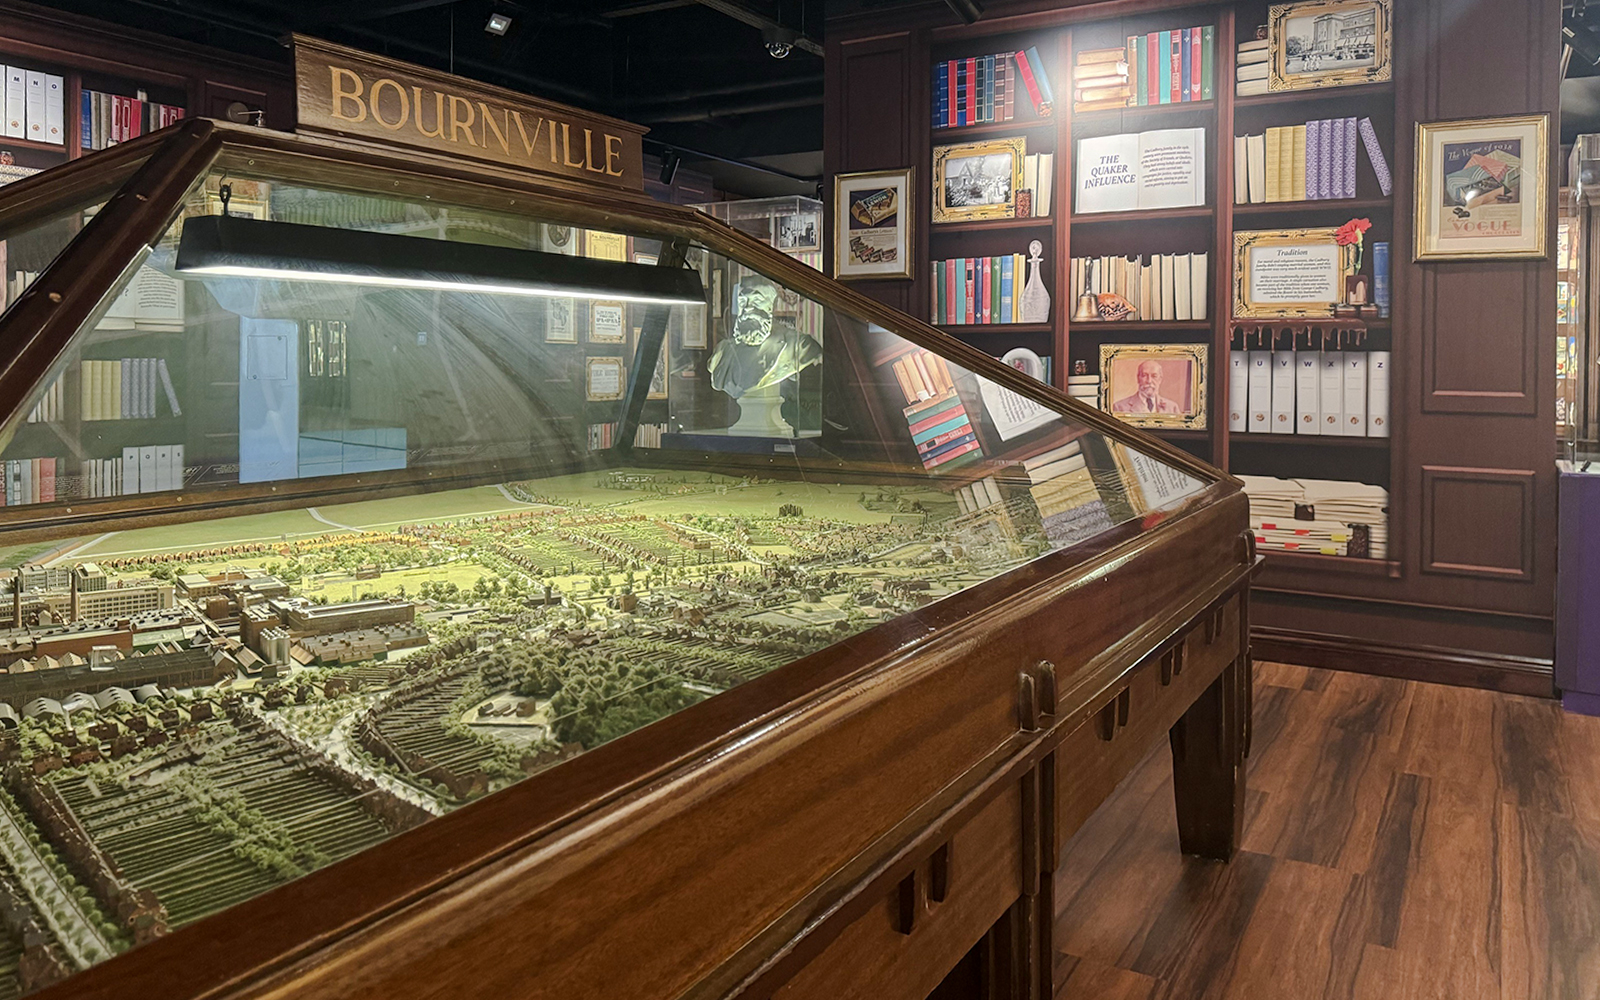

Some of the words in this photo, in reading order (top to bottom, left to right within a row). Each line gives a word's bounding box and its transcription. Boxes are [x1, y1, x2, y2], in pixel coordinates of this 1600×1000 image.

[328, 65, 624, 178] BOURNVILLE
[1100, 154, 1120, 164] THE
[1091, 164, 1128, 178] QUAKER
[1084, 174, 1136, 189] INFLUENCE
[1452, 220, 1512, 232] VOGUE
